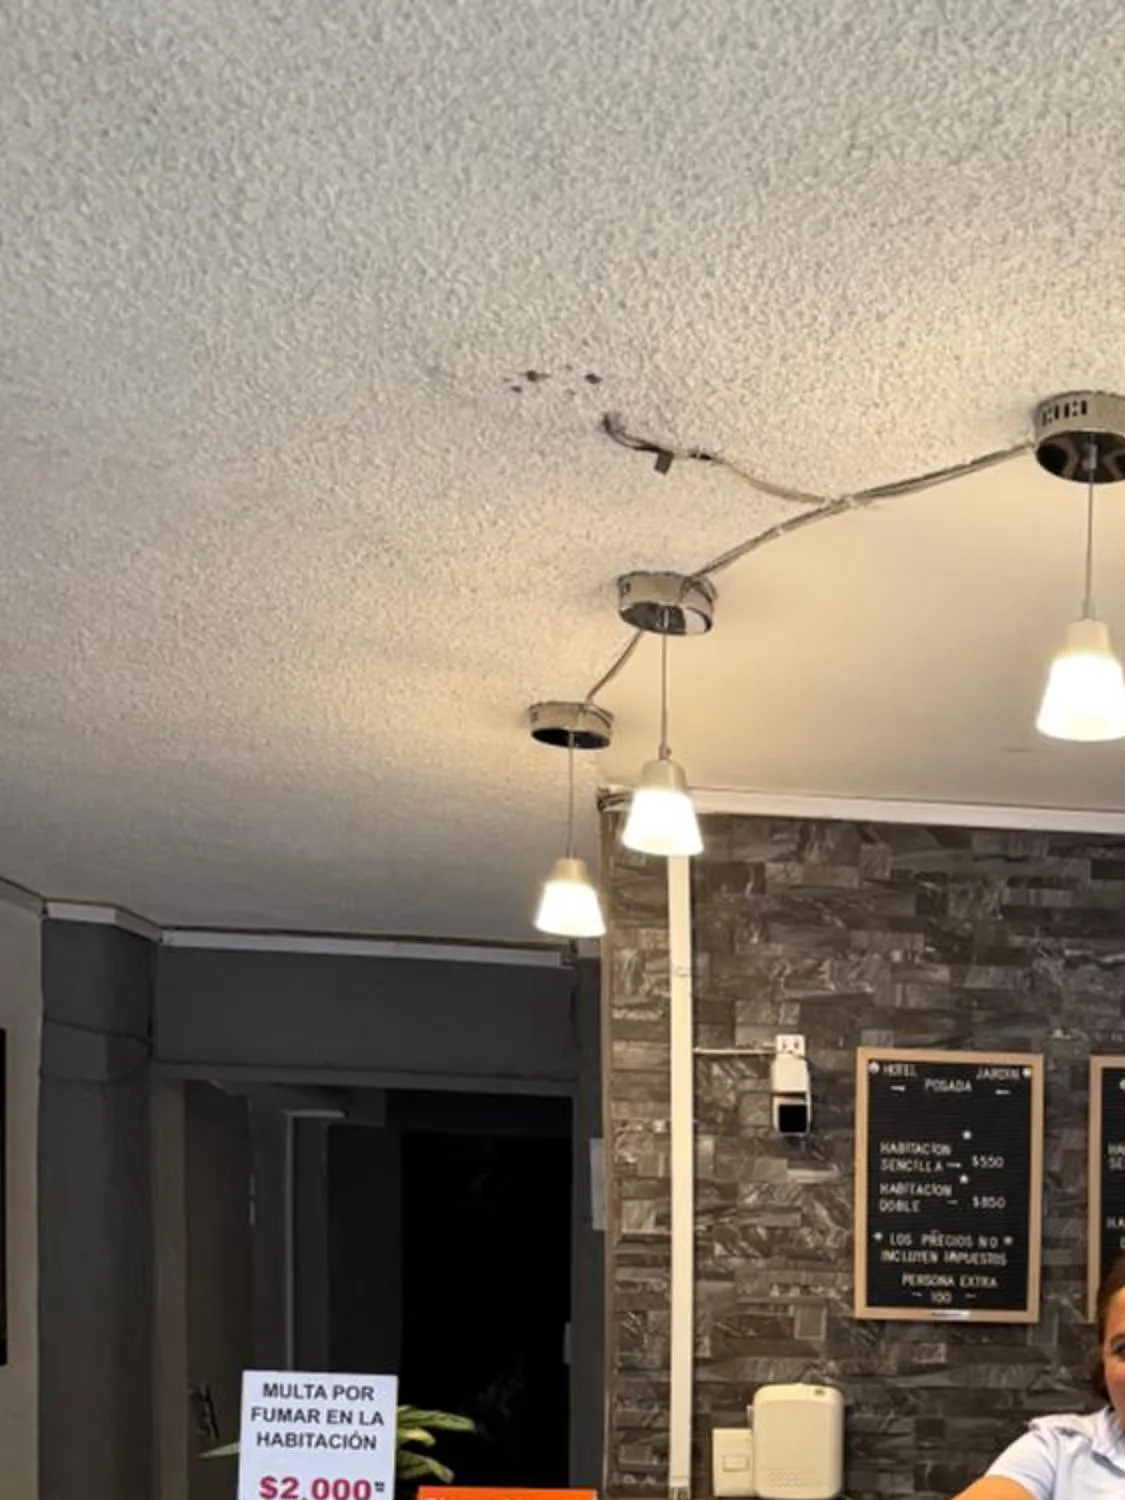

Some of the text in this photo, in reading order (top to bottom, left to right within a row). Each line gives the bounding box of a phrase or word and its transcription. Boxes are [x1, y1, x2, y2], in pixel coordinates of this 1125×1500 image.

[924, 1079, 972, 1092] POSADA
[880, 1142, 951, 1156] HABITACION
[880, 1158, 944, 1172] SENCILLA
[880, 1183, 952, 1197] HABITACION
[880, 1199, 920, 1213] DOBLE
[890, 1232, 912, 1247] LOS
[978, 1235, 999, 1249] NO
[943, 1252, 1007, 1266] IMPUESTOS
[902, 1274, 998, 1289] PERSONA EXTRA
[263, 1383, 374, 1401] MULTA POR
[250, 1406, 384, 1426] FUMAR EN LA
[256, 1430, 377, 1451] HABITACIÓN
